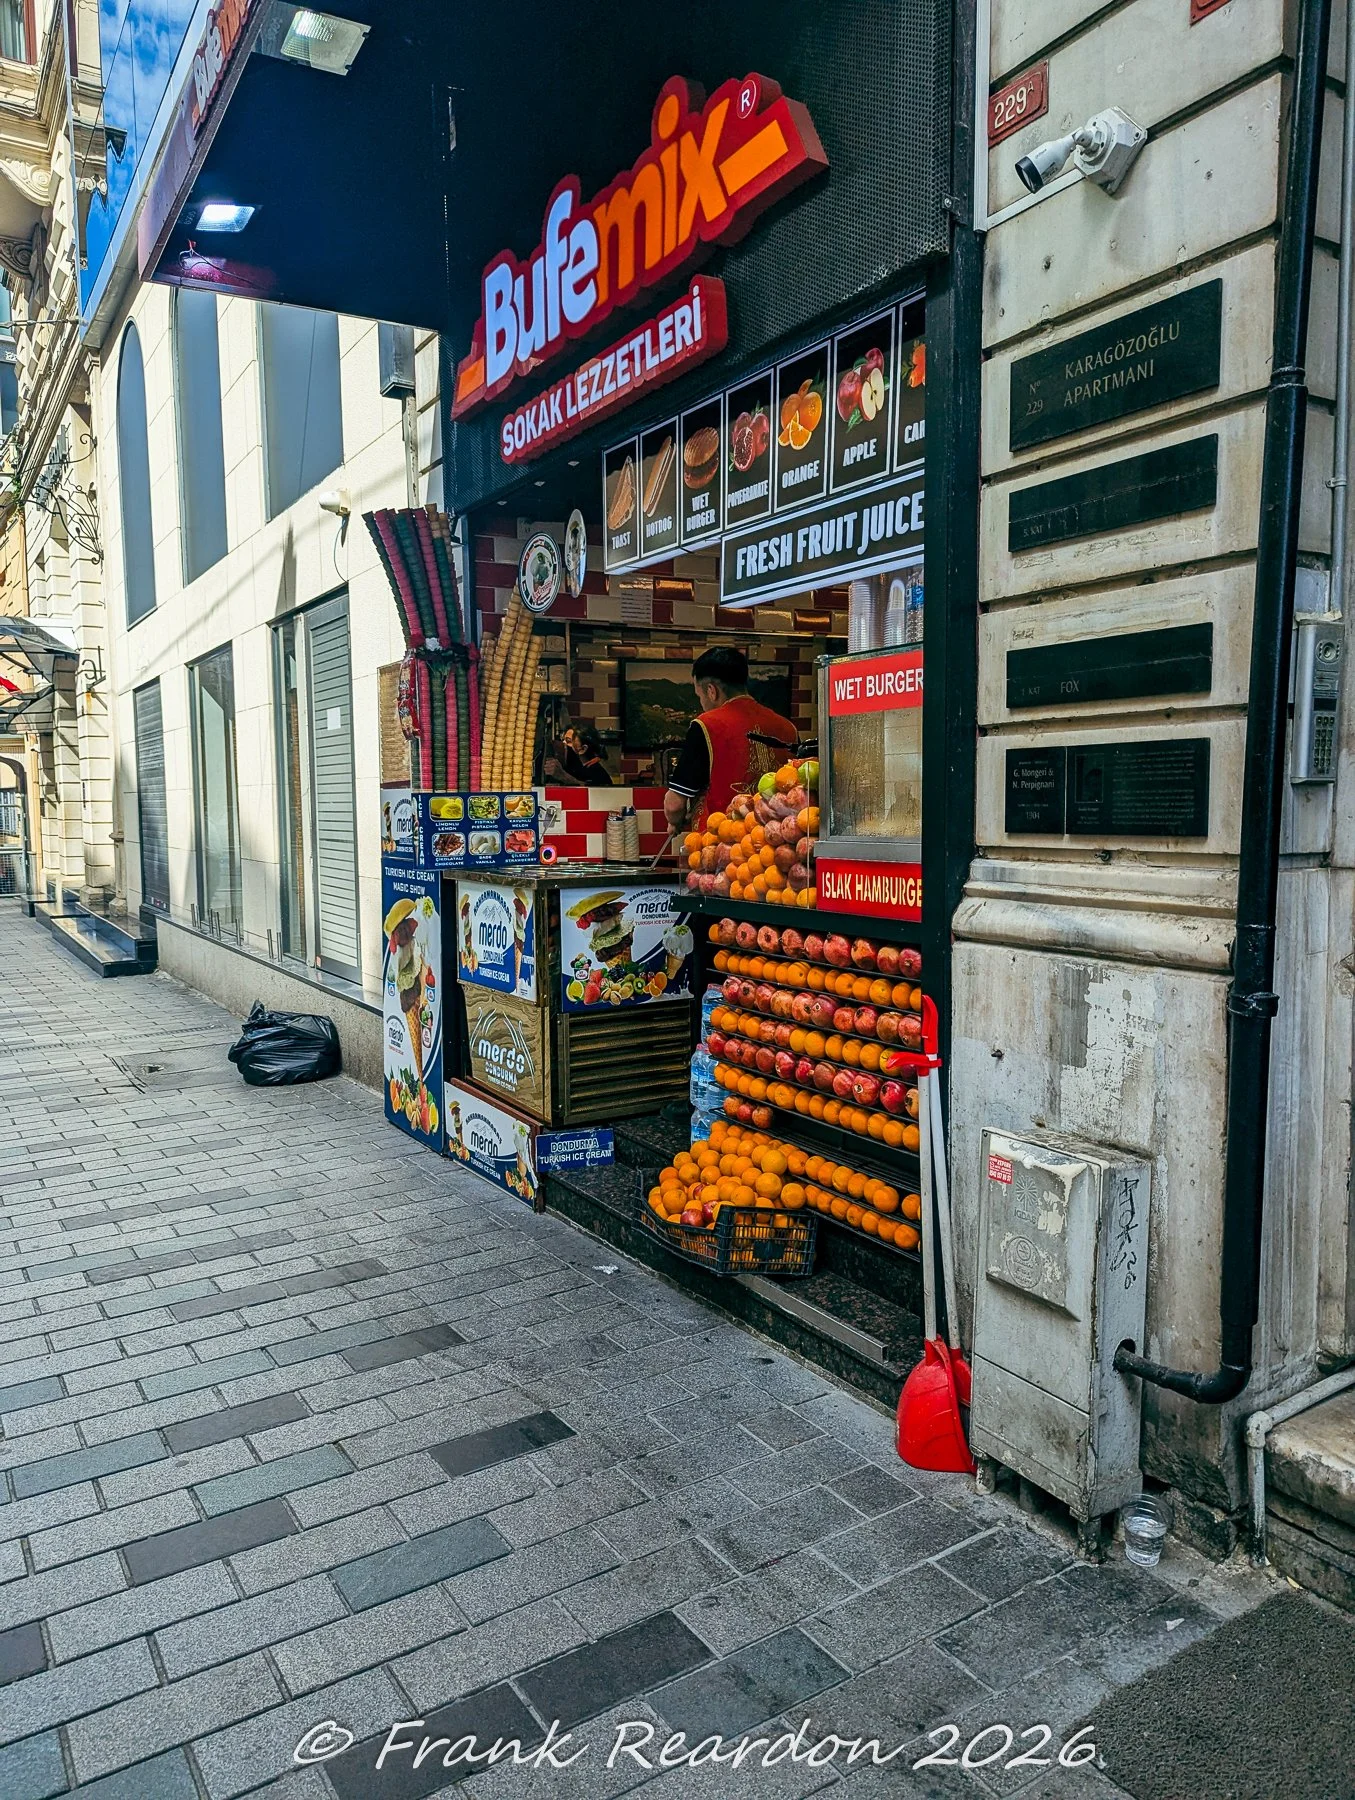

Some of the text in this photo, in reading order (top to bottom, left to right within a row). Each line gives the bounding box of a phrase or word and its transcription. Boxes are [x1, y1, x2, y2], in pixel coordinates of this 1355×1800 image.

[484, 93, 730, 388] Bufemix
[1065, 321, 1180, 380] KARAGÖZOĞLU
[503, 285, 702, 457] SOKAK LEZZETLERİ
[1064, 359, 1154, 407] APARTMANI
[1026, 399, 1043, 417] 229
[843, 438, 877, 467] APPLE
[782, 460, 820, 489] ORANGE
[692, 492, 710, 512] WET
[727, 479, 769, 509] POMEGRANATE
[646, 515, 672, 538] HOTDOG
[686, 508, 716, 532] BURGER
[612, 531, 631, 550] TOAST
[736, 491, 925, 580] FRESH FRUIT JUICE
[834, 668, 924, 701] WET BURGER
[1060, 679, 1080, 693] FOX
[1020, 779, 1055, 790] Perpignani
[384, 867, 435, 882] TURKISH ICE CREAM
[393, 882, 426, 895] MAGIC SHOW
[822, 872, 922, 907] ISLAK HAMBURGE
[636, 899, 671, 914] merd
[479, 921, 508, 950] merdo
[478, 1039, 525, 1073] merdo
[485, 1060, 518, 1086] DONDURMA
[540, 1149, 612, 1164] TURKISH ICE CREAM
[550, 1138, 600, 1153] DONDURMA
